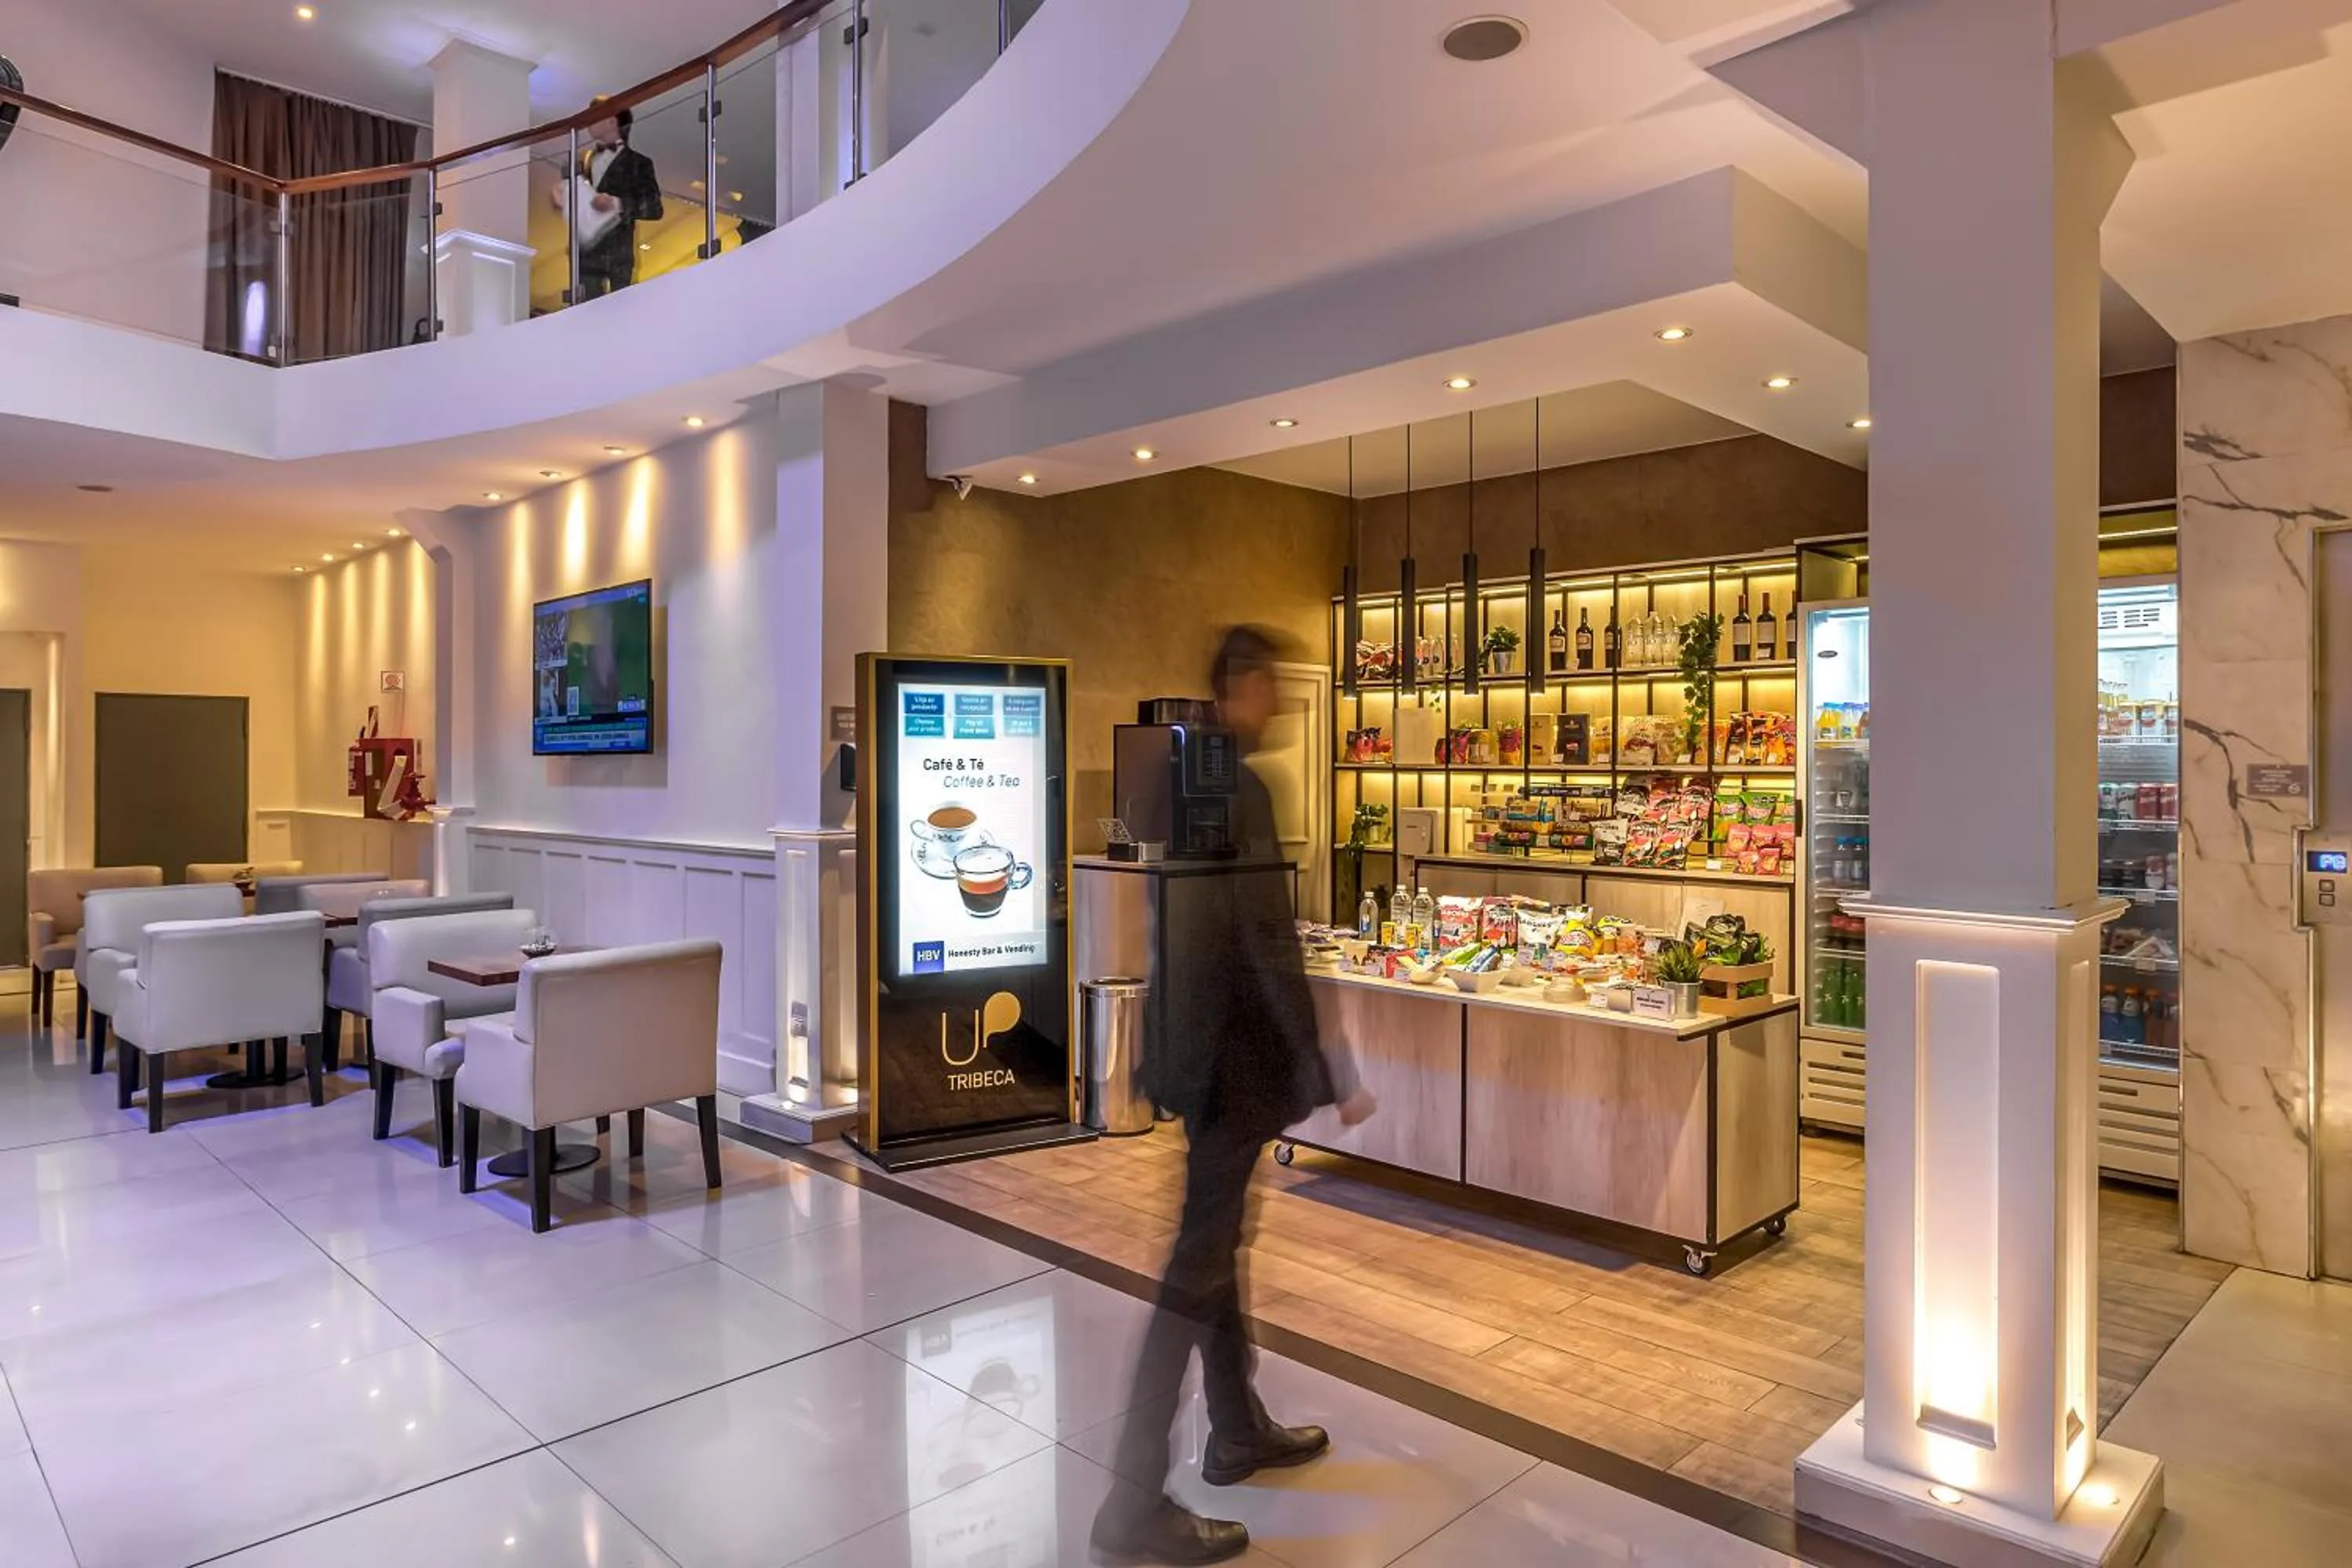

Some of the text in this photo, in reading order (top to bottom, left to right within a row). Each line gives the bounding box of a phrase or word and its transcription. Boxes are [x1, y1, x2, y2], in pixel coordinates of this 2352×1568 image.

[923, 757, 985, 771] Café & Té
[943, 774, 1020, 788] Coffee & Tea
[916, 943, 1036, 962] HBV Honesty Bar & Vending
[947, 1068, 1016, 1091] TRIBECA
